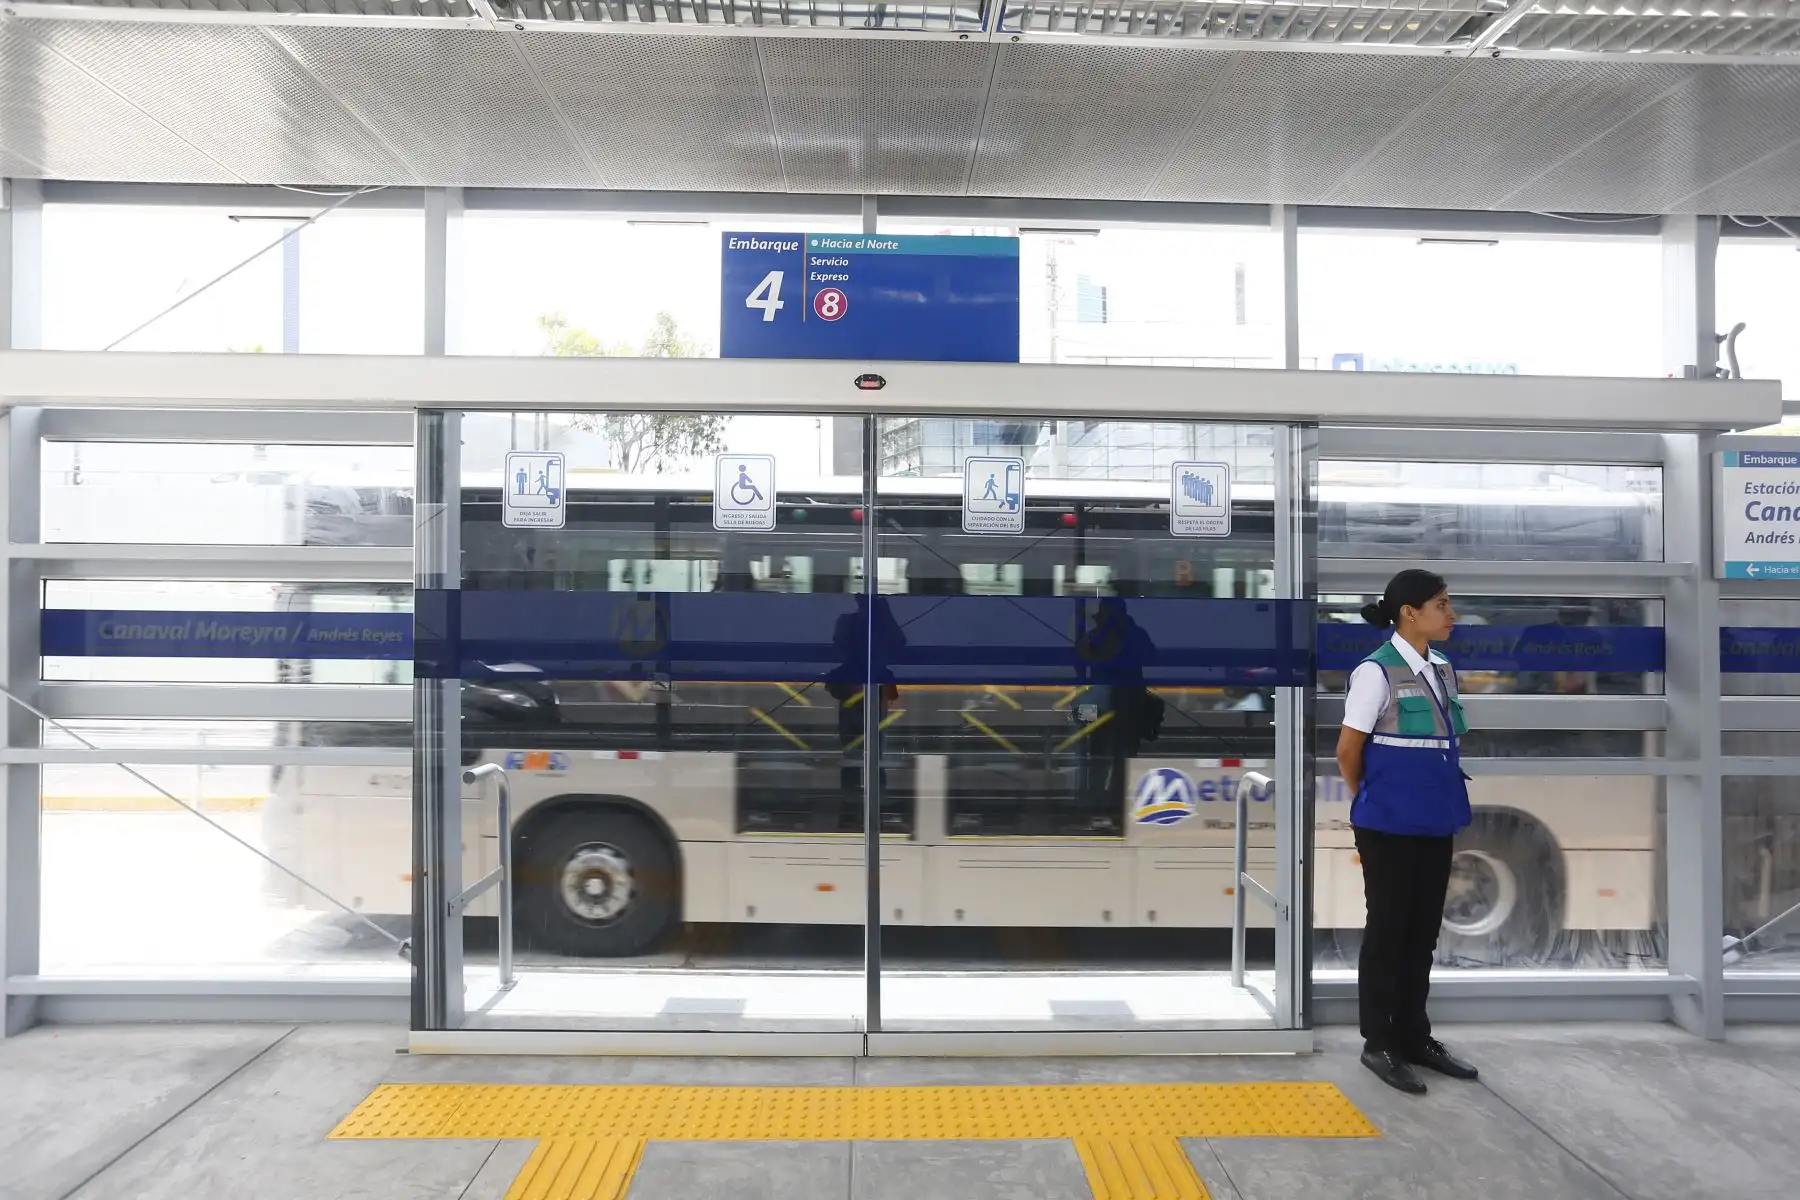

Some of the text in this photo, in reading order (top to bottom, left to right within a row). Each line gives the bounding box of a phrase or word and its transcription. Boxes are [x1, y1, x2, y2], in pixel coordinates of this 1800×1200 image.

[728, 237, 799, 253] Embarque
[821, 238, 899, 250] Hacia el Norte
[810, 256, 849, 266] Servicio
[810, 271, 849, 282] Expreso
[745, 270, 785, 322] 4
[821, 292, 840, 317] 8
[1744, 454, 1798, 466] Embarque
[1744, 530, 1795, 544] Andrés
[1764, 565, 1800, 574] Hacia el
[98, 619, 191, 640] Canaval
[195, 622, 287, 646] Moreyra
[307, 628, 361, 643] Andrés
[362, 628, 403, 645] Reyes
